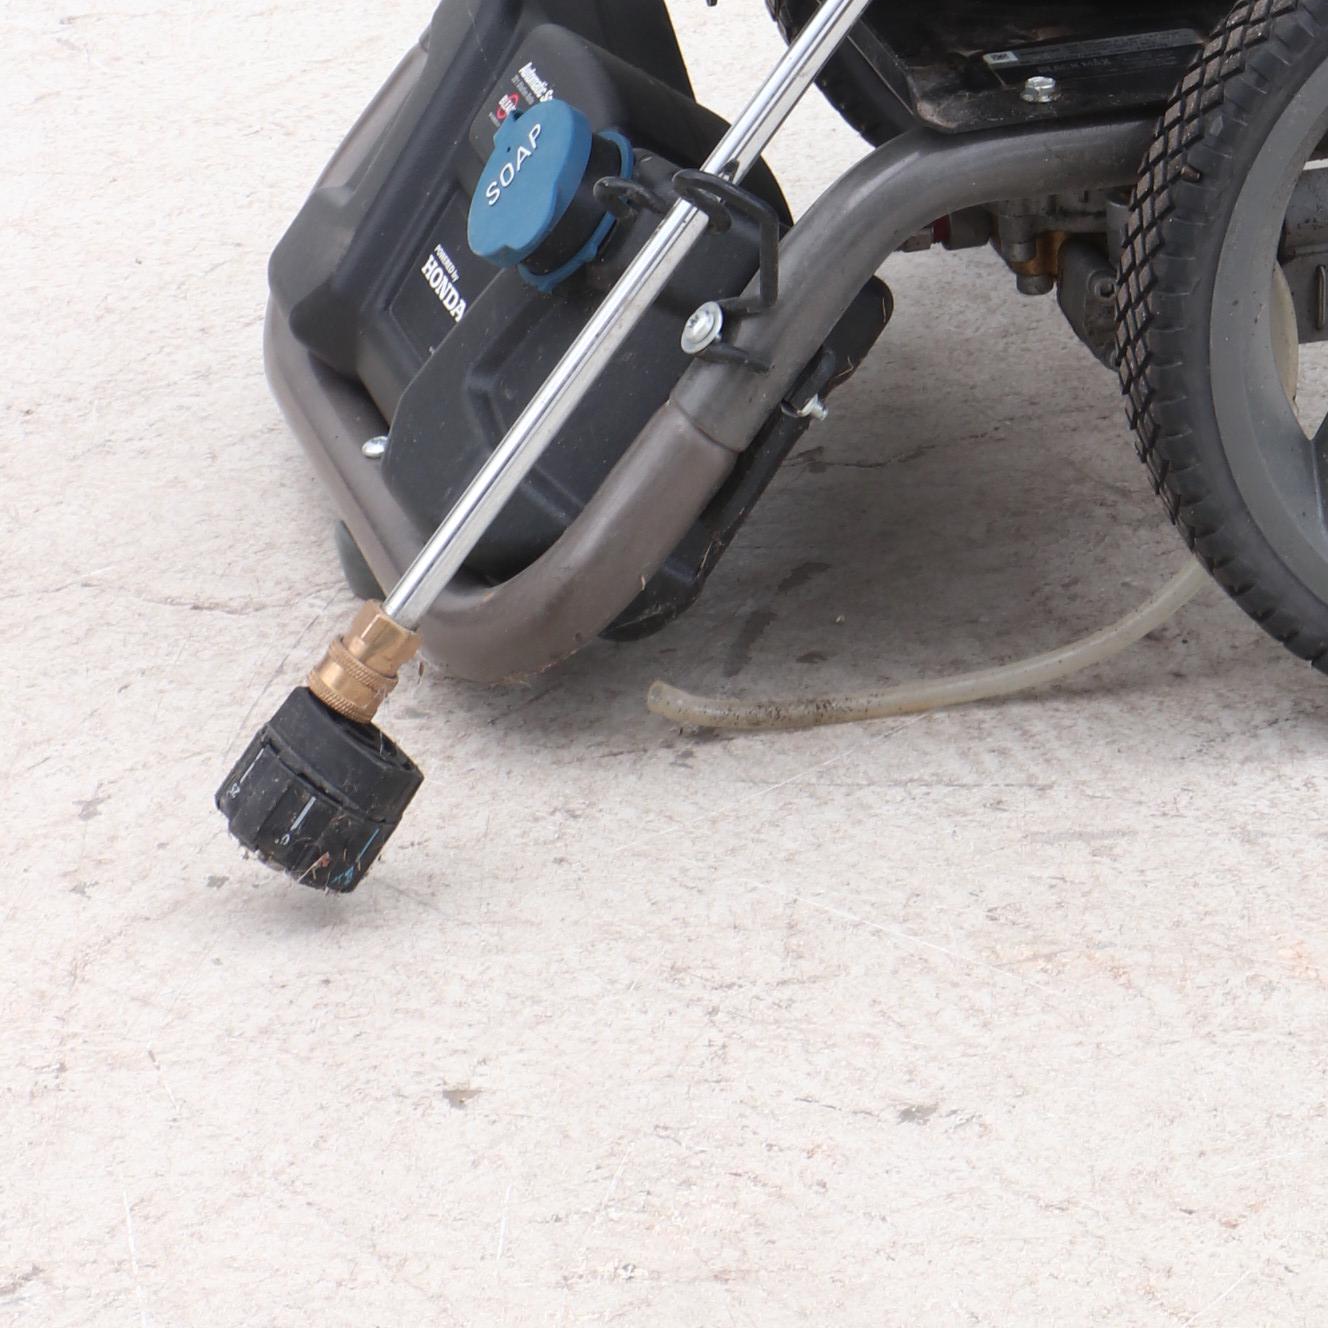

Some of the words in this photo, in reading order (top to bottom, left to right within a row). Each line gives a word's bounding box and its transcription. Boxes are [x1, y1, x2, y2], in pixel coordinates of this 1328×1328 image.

[485, 122, 542, 207] SOAP
[421, 253, 467, 323] HONDA
[433, 243, 456, 274] POWERED
[451, 269, 460, 283] by
